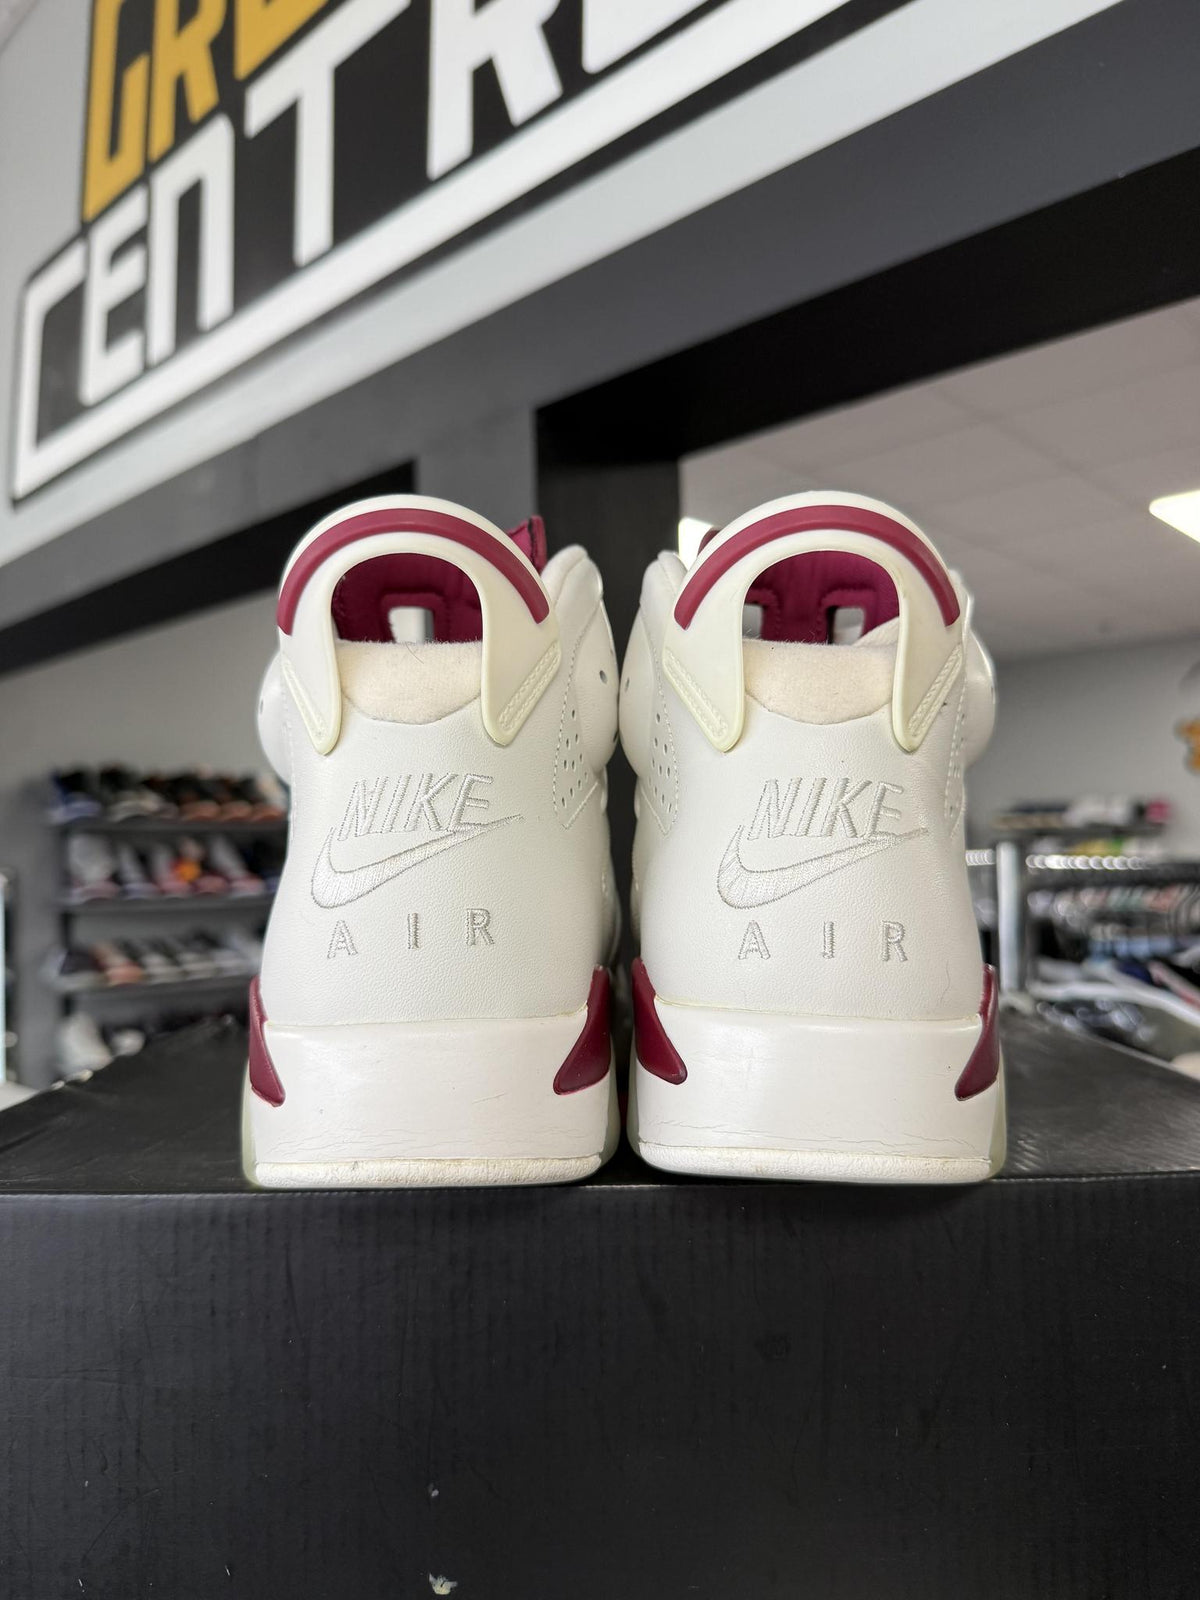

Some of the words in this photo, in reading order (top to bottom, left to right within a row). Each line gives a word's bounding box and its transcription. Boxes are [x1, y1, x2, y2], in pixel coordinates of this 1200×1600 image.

[9, 0, 725, 498] CENTR
[337, 772, 495, 841] NIKE
[747, 777, 905, 841] NIKE
[327, 908, 496, 959] AIR
[737, 919, 908, 962] AIR
